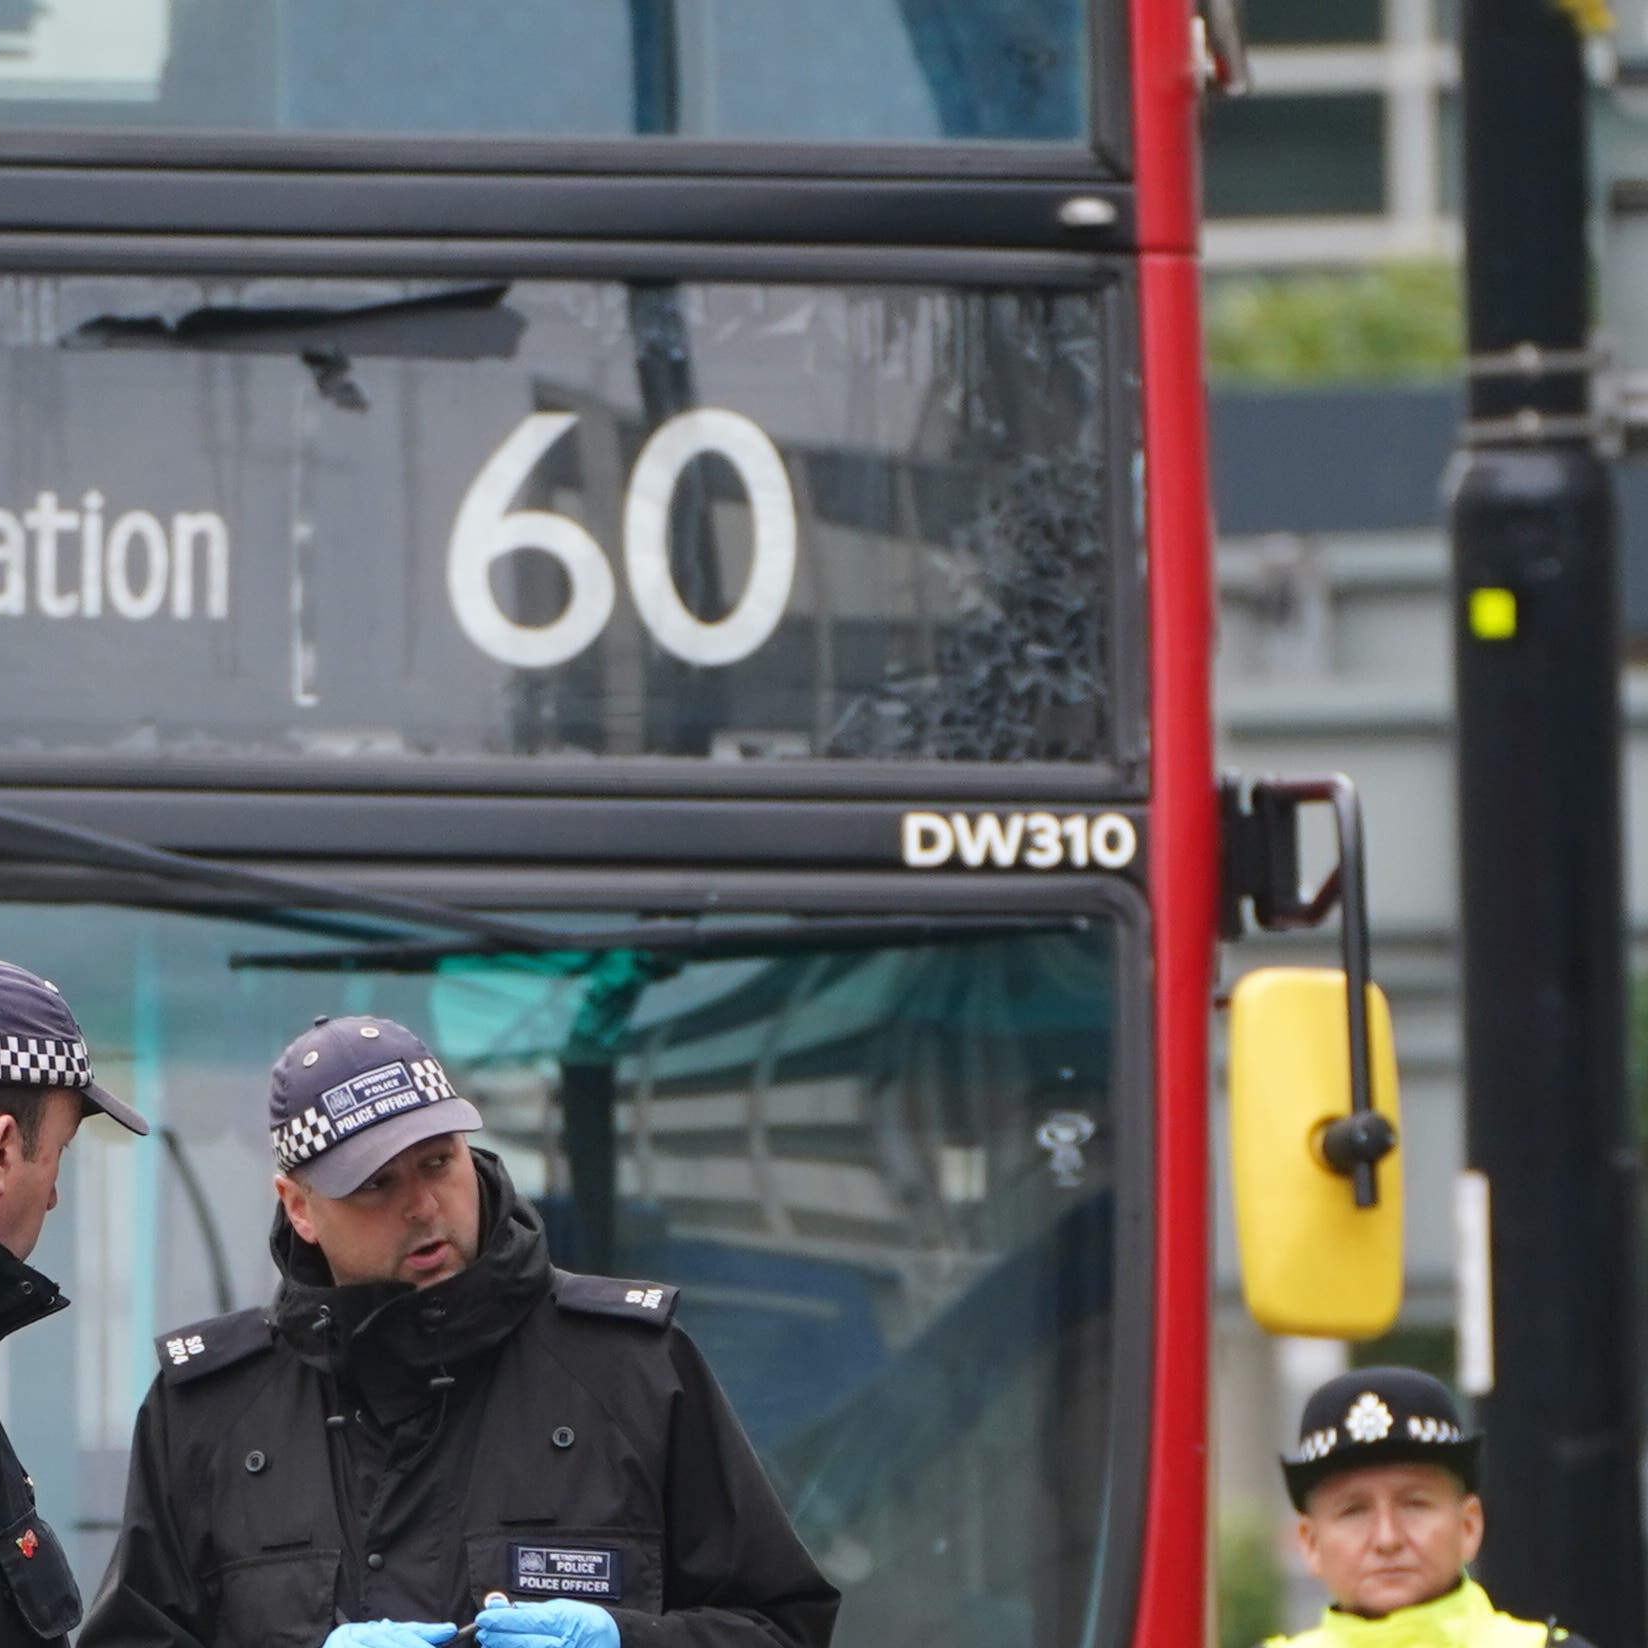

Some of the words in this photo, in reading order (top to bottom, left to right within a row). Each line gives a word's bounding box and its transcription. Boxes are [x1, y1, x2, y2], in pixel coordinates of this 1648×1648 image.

[446, 408, 796, 668] 60
[903, 811, 1138, 869] DW310
[352, 1067, 402, 1091] METROPOLITAN
[363, 1078, 400, 1097] POLICE
[336, 1107, 377, 1135] POLICE
[376, 1090, 422, 1115] OFFICER
[549, 1553, 603, 1564] METROPOLITAN
[556, 1562, 596, 1574] POLICE
[519, 1576, 560, 1590] POLICE
[561, 1579, 610, 1593] OFFICER
